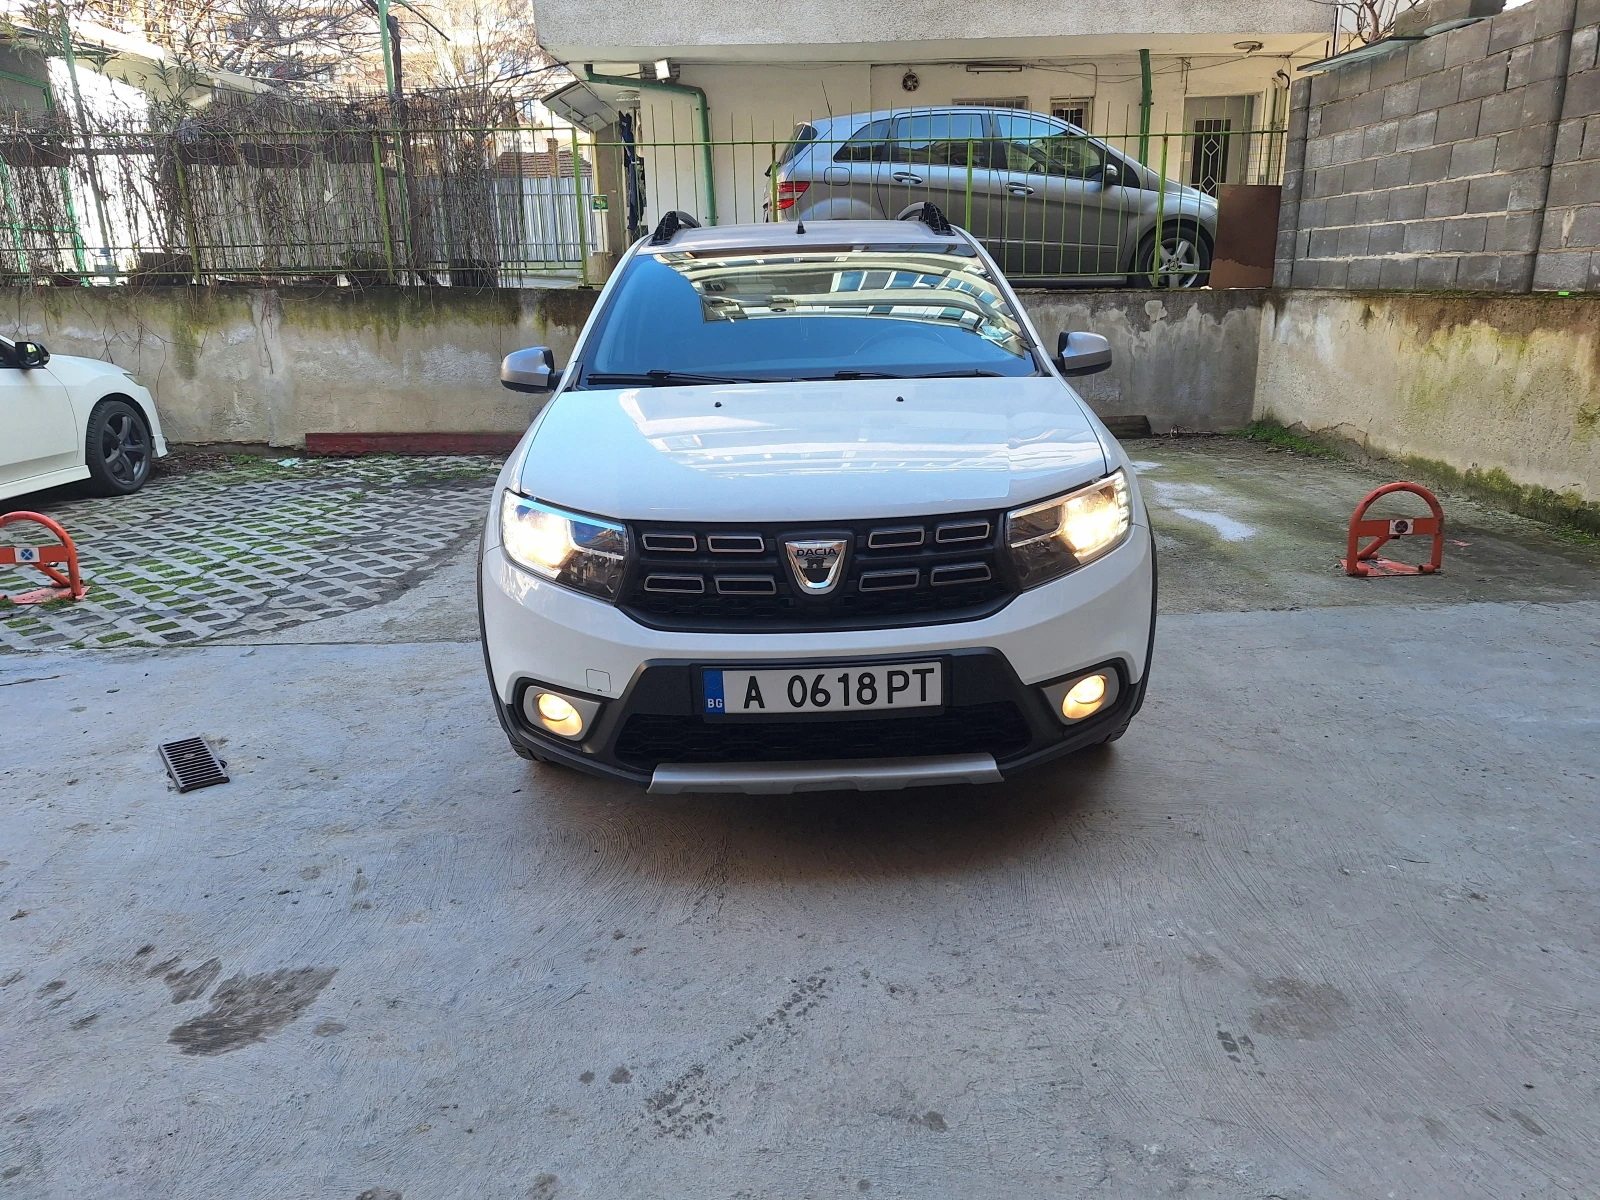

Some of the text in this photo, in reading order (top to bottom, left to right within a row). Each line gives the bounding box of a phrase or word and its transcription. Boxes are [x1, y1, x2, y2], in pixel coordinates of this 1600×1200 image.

[796, 548, 837, 557] DACIA
[743, 675, 766, 709] A
[707, 698, 723, 709] BG
